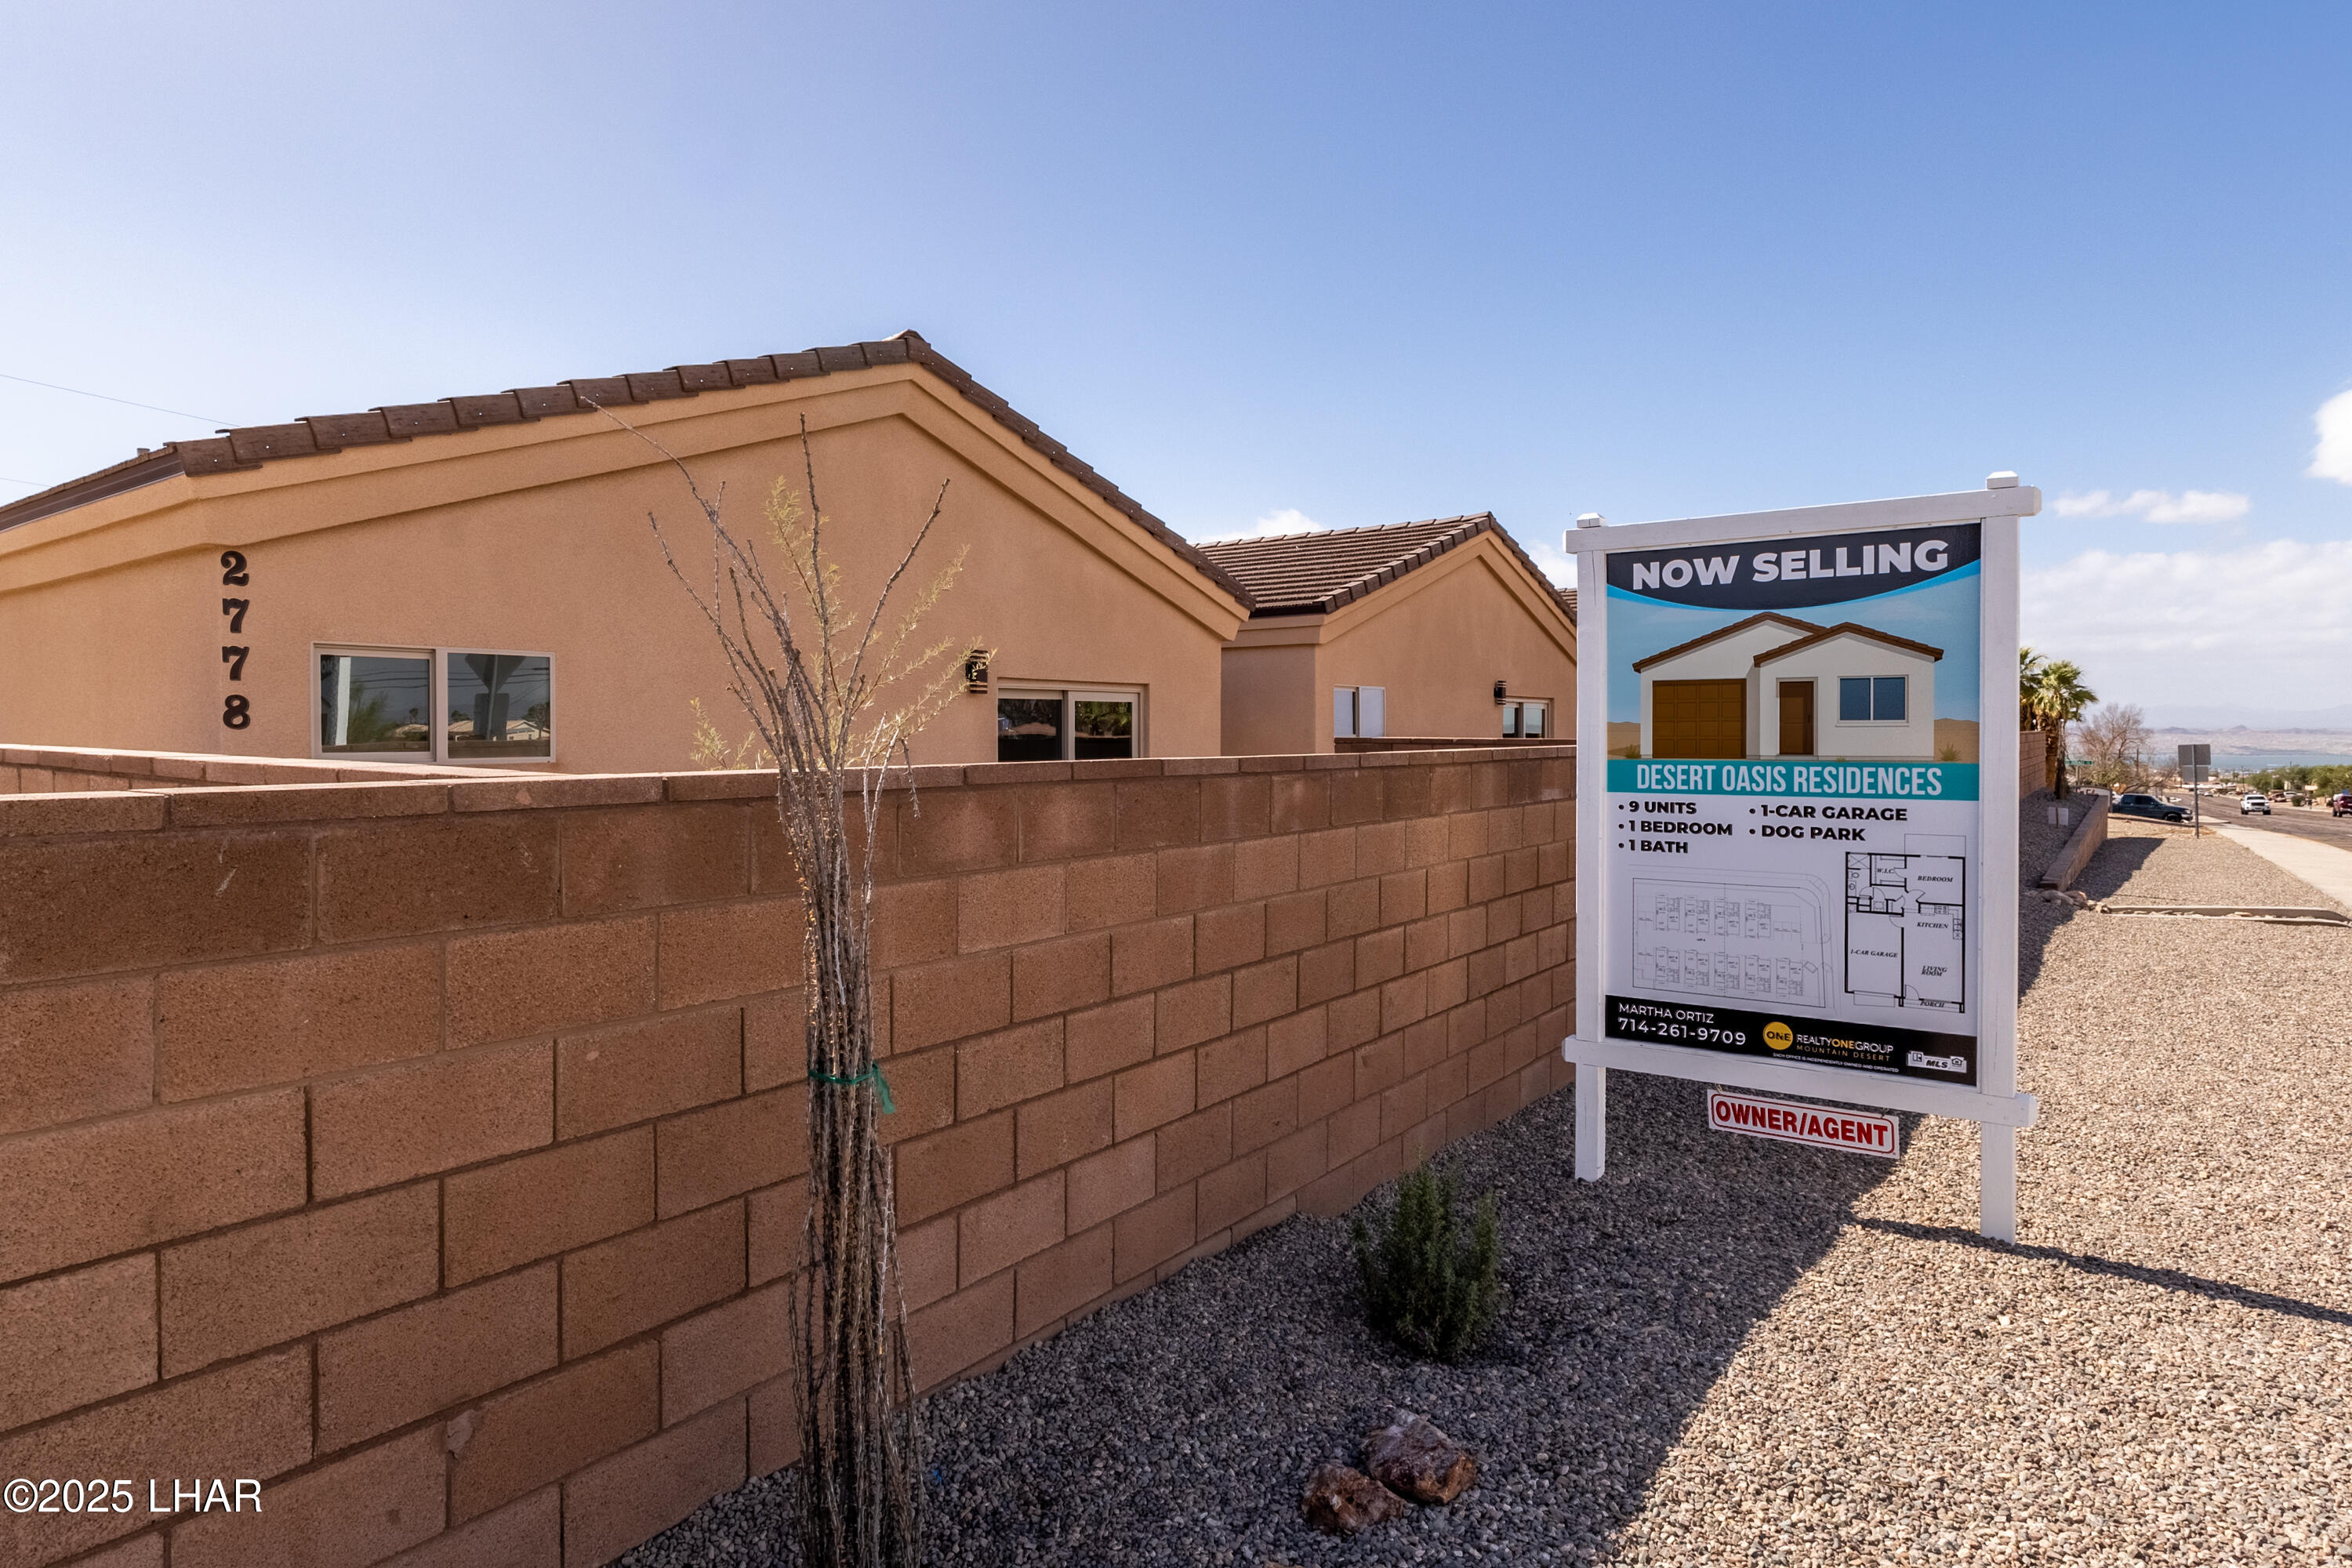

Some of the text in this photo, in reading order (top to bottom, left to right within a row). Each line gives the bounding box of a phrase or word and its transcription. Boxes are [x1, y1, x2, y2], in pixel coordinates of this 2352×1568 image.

[1632, 539, 1948, 590] NOW SELLING
[220, 550, 251, 730] 2778
[1637, 764, 1943, 795] DESERT OASIS RESIDENCES
[1628, 800, 1697, 815] 9 UNITS
[1761, 804, 1907, 821] 1-CAR GARAGE
[1628, 820, 1733, 836] 1 BEDROOM
[1762, 825, 1866, 841] DOG PARK
[1628, 839, 1688, 853] 1 BATH
[1618, 1003, 1715, 1024] MARTHA ORTIZ
[1617, 1017, 1747, 1045] 714-261-9709
[1766, 1031, 1791, 1042] ONE
[1796, 1044, 1890, 1062] MOUNTAIN DESERT
[1926, 1059, 1948, 1069] MLS
[1715, 1100, 1888, 1146] OWNER/AGENT
